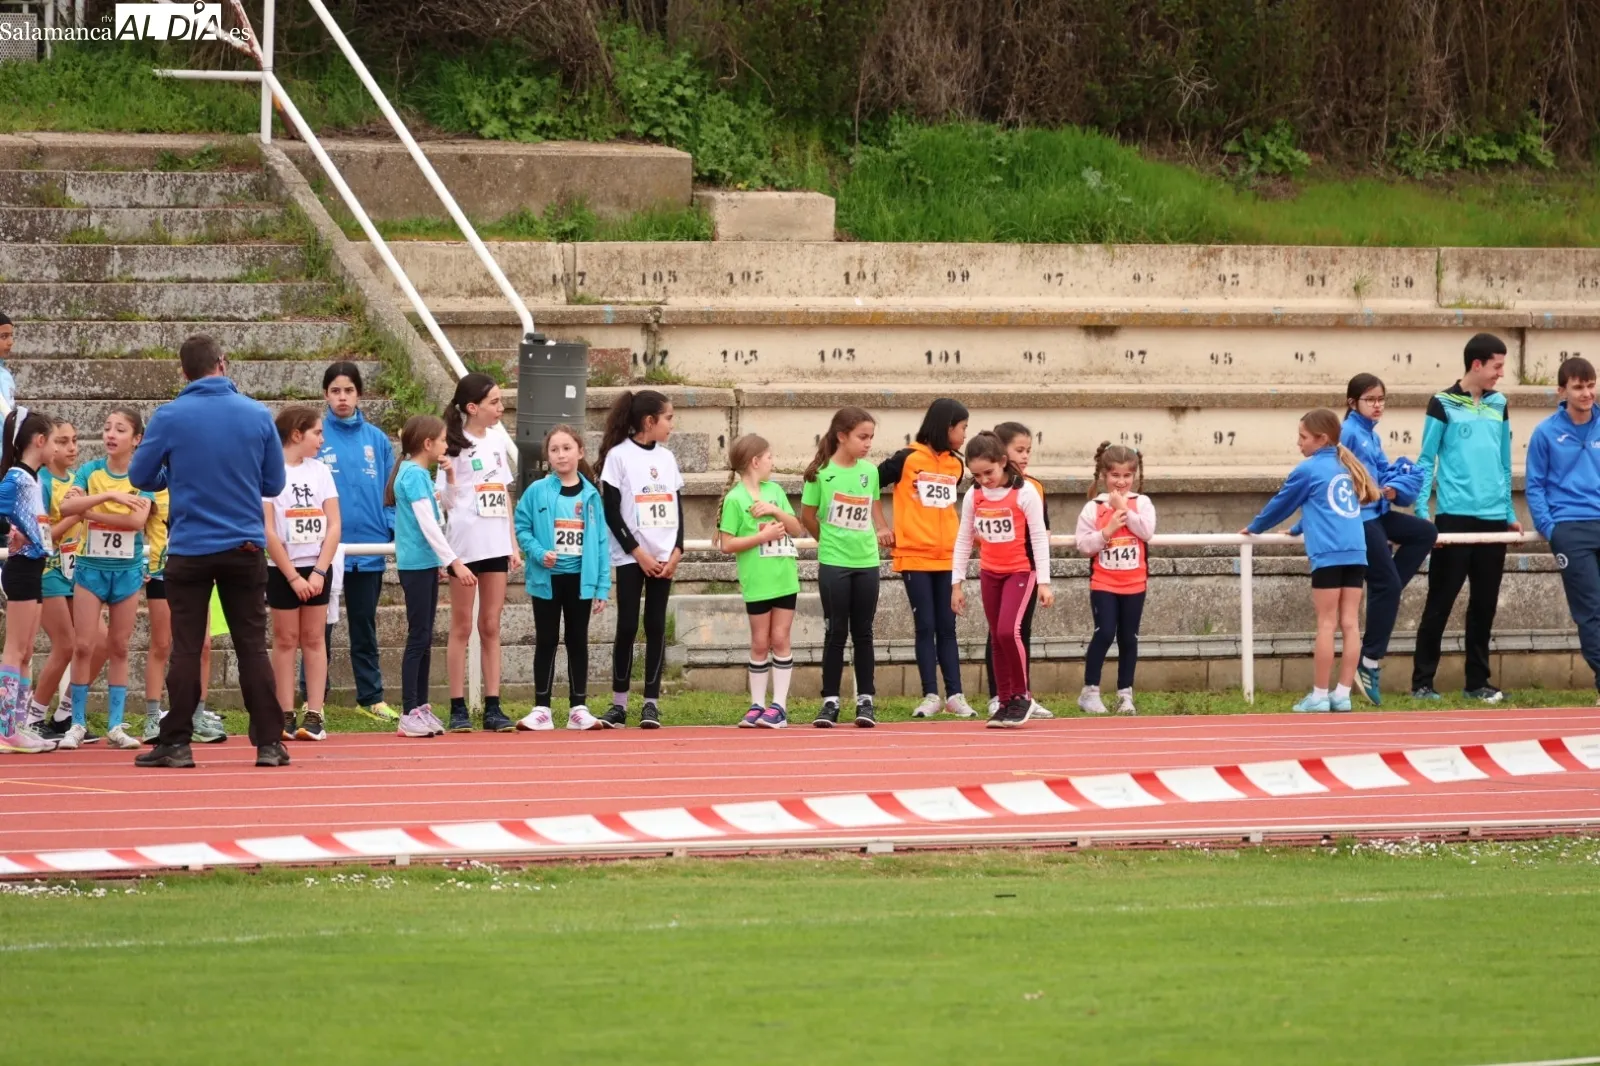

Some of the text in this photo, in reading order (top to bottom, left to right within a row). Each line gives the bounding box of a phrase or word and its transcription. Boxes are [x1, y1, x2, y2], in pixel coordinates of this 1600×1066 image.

[640, 270, 678, 286] 105
[843, 271, 878, 285] 101
[1043, 272, 1064, 286] 97
[1306, 273, 1326, 287] 91
[924, 350, 961, 365] 101
[1023, 350, 1046, 364] 99
[1125, 350, 1147, 364] 97
[1213, 431, 1236, 446] 97
[926, 484, 950, 500] 258
[650, 504, 667, 518] 18
[836, 504, 868, 521] 1182
[295, 519, 322, 533] 549
[978, 519, 1012, 534] 1139
[102, 532, 122, 548] 78
[556, 530, 584, 546] 288
[1103, 547, 1136, 562] 1141
